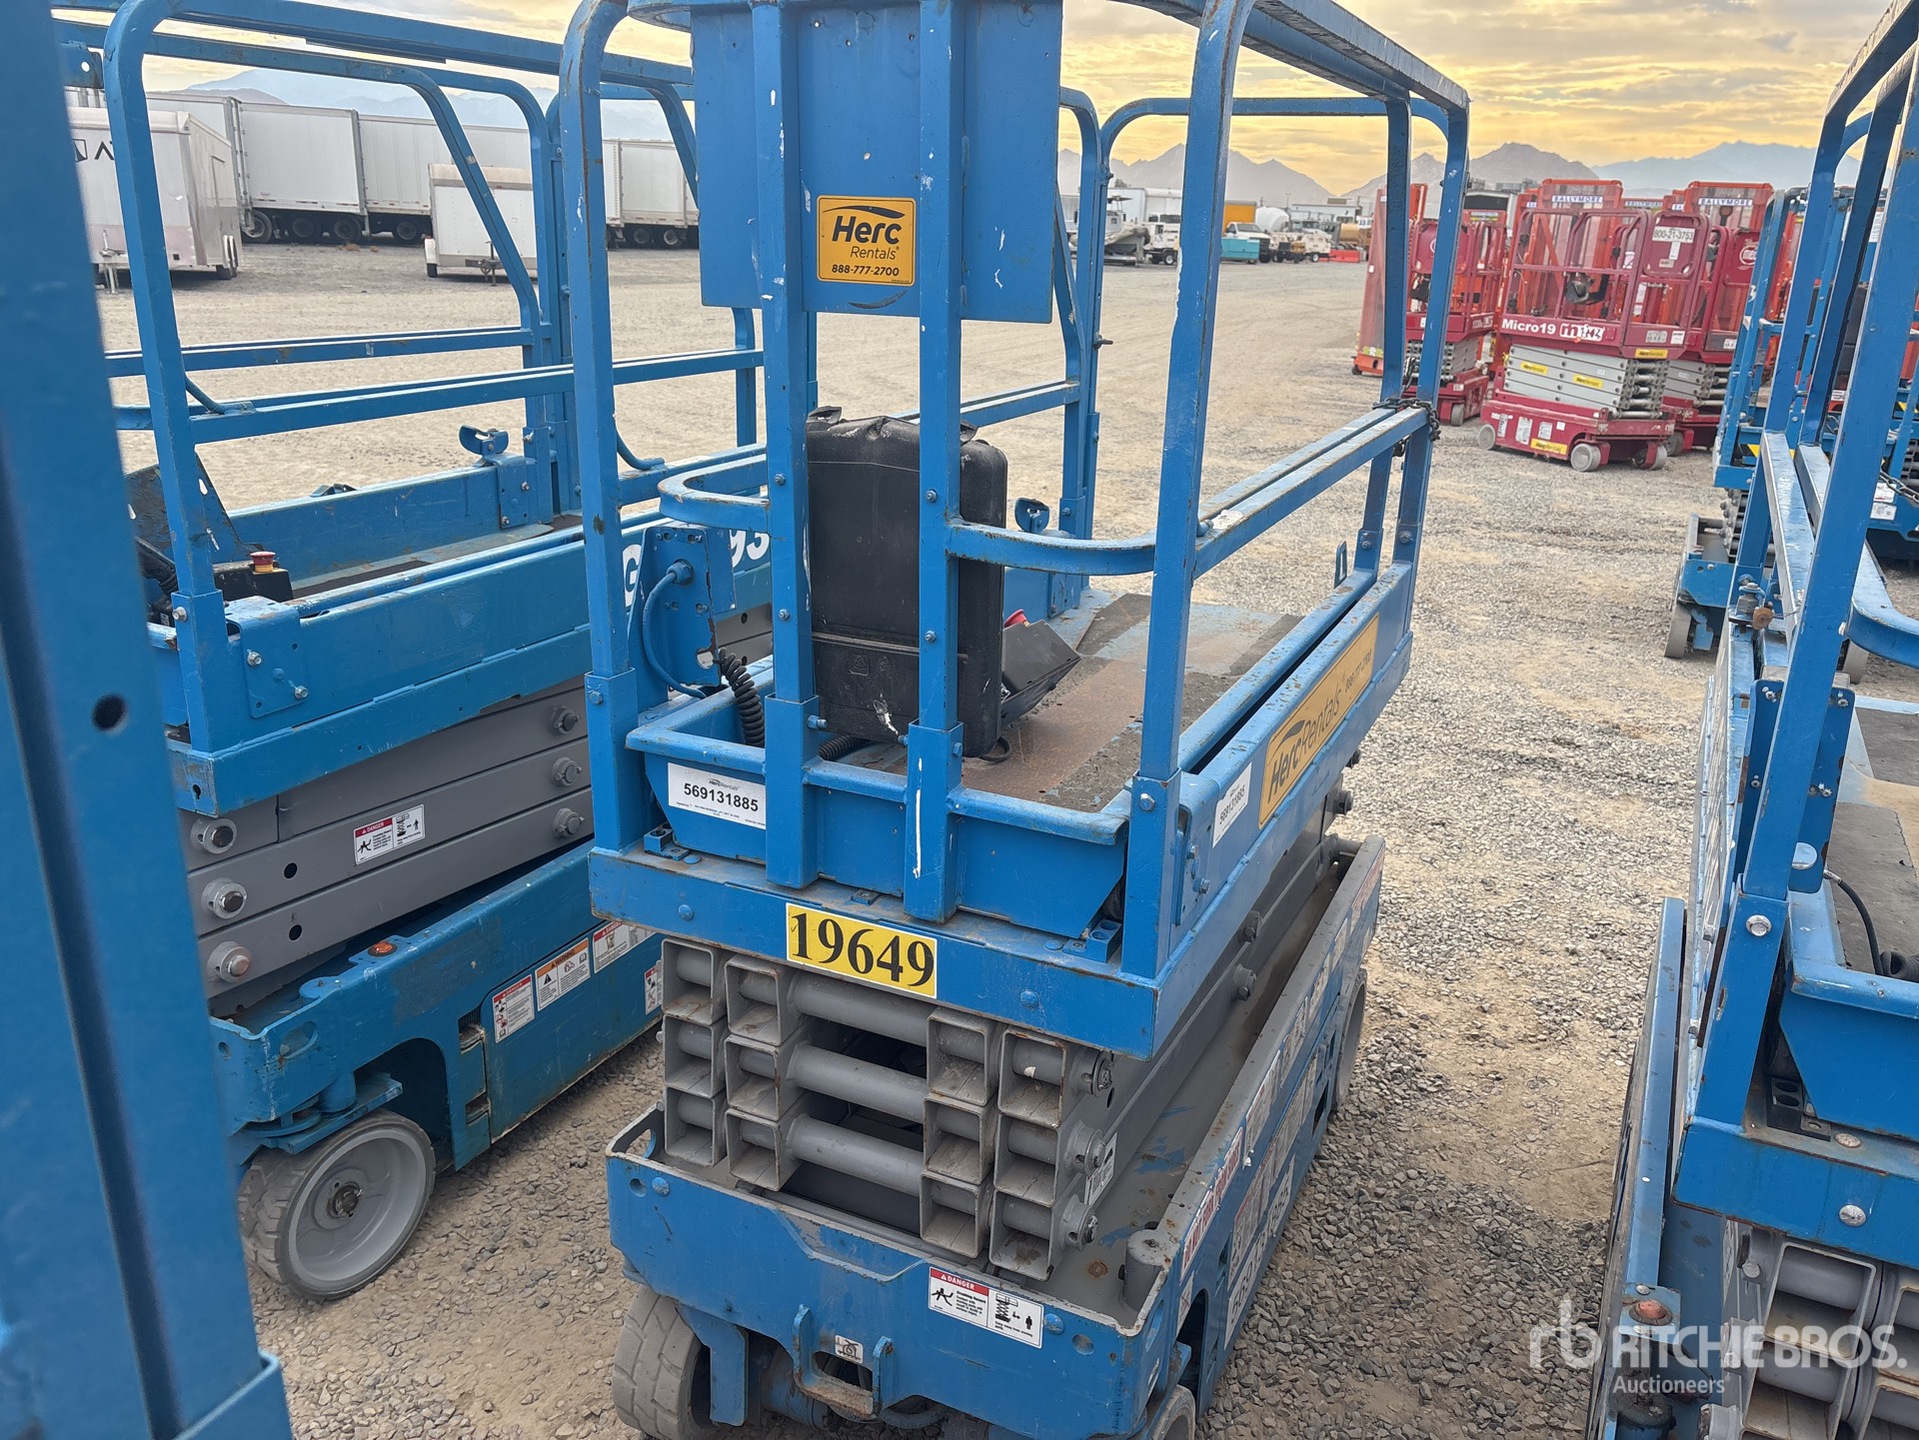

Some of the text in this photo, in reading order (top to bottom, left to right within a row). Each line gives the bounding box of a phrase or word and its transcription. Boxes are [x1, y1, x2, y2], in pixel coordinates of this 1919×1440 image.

[832, 215, 902, 245] Herc
[850, 246, 897, 260] Rentals
[832, 264, 900, 277] 888-777-2700
[1501, 318, 1556, 334] Micro19
[684, 783, 758, 812] 569131885
[366, 822, 384, 832] DANGER
[791, 912, 934, 987] 19649
[947, 1275, 975, 1290] DANGER
